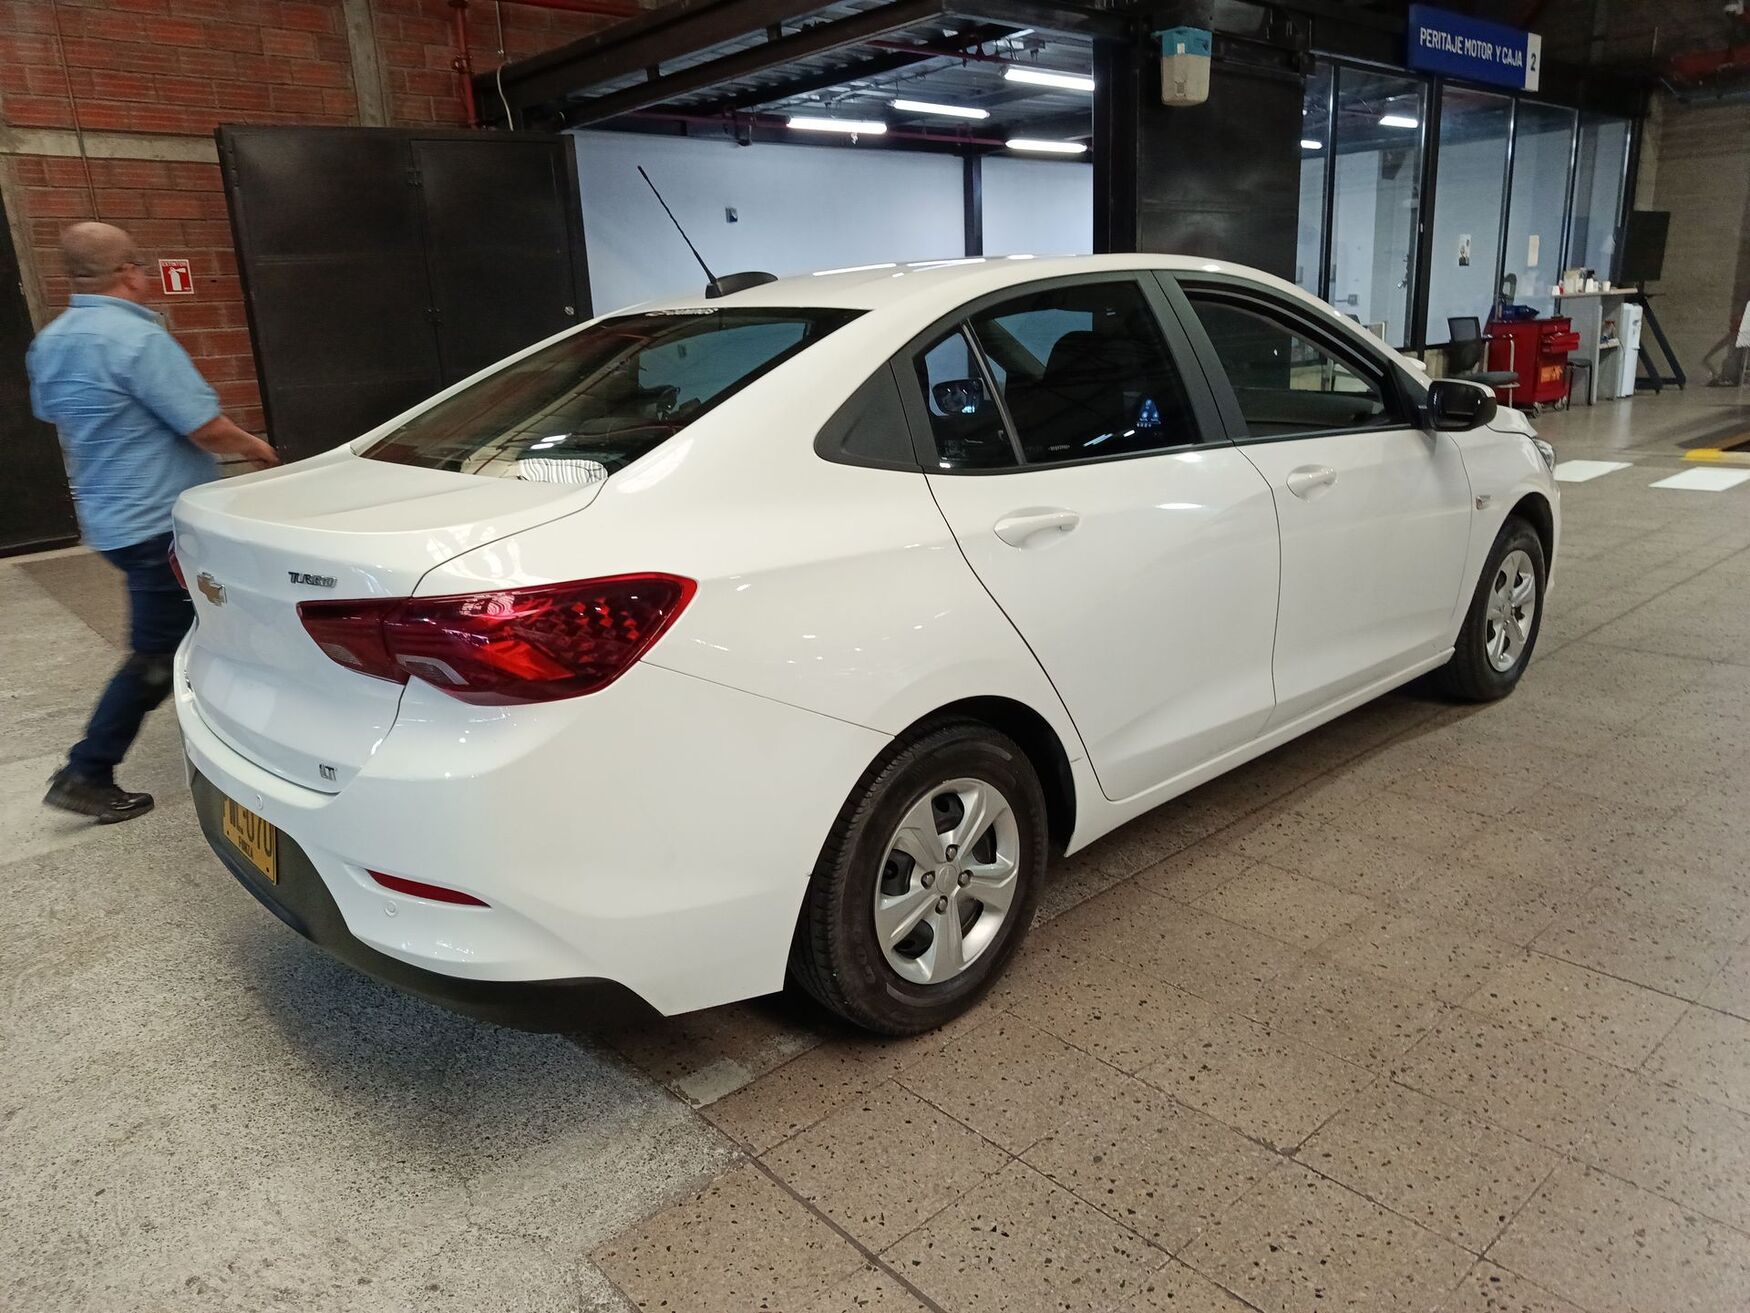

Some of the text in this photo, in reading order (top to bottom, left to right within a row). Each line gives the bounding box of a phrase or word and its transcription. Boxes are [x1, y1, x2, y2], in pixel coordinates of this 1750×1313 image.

[1420, 27, 1523, 68] PERITAJE MOTOR Y CAJA
[1530, 53, 1536, 72] 2
